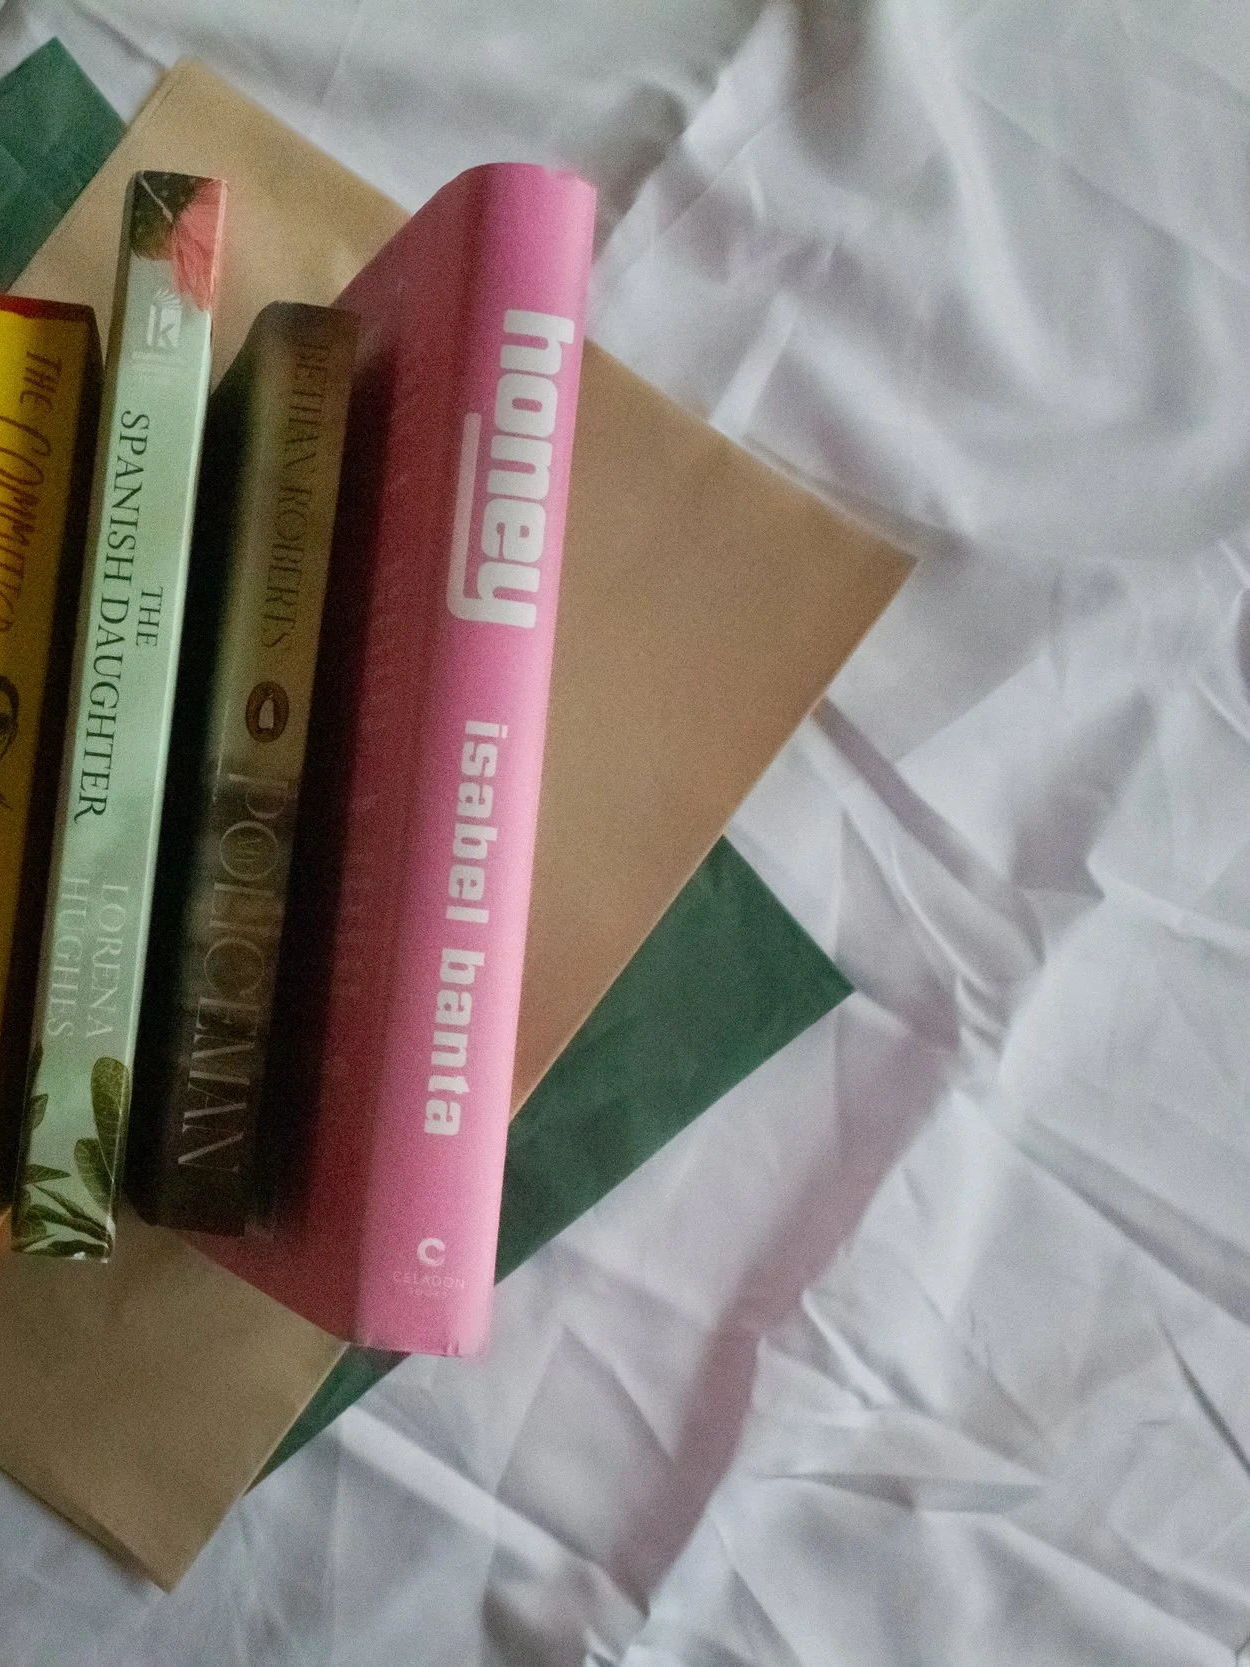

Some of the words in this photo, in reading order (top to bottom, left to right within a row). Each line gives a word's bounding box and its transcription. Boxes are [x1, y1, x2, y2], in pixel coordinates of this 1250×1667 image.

[20, 351, 63, 407] THE
[280, 338, 333, 474] BETHAN
[105, 409, 152, 588] SPANISH
[446, 309, 576, 629] honey
[134, 584, 165, 650] THE
[261, 478, 313, 653] ROBERTS
[73, 595, 132, 824] DAUGHTER
[445, 720, 508, 924] isabel
[47, 877, 91, 1041] HUGHES
[86, 883, 130, 1041] LORENA
[177, 772, 290, 1173] POLICEMAN
[423, 947, 486, 1137] banta
[392, 1271, 466, 1290] CELADON
